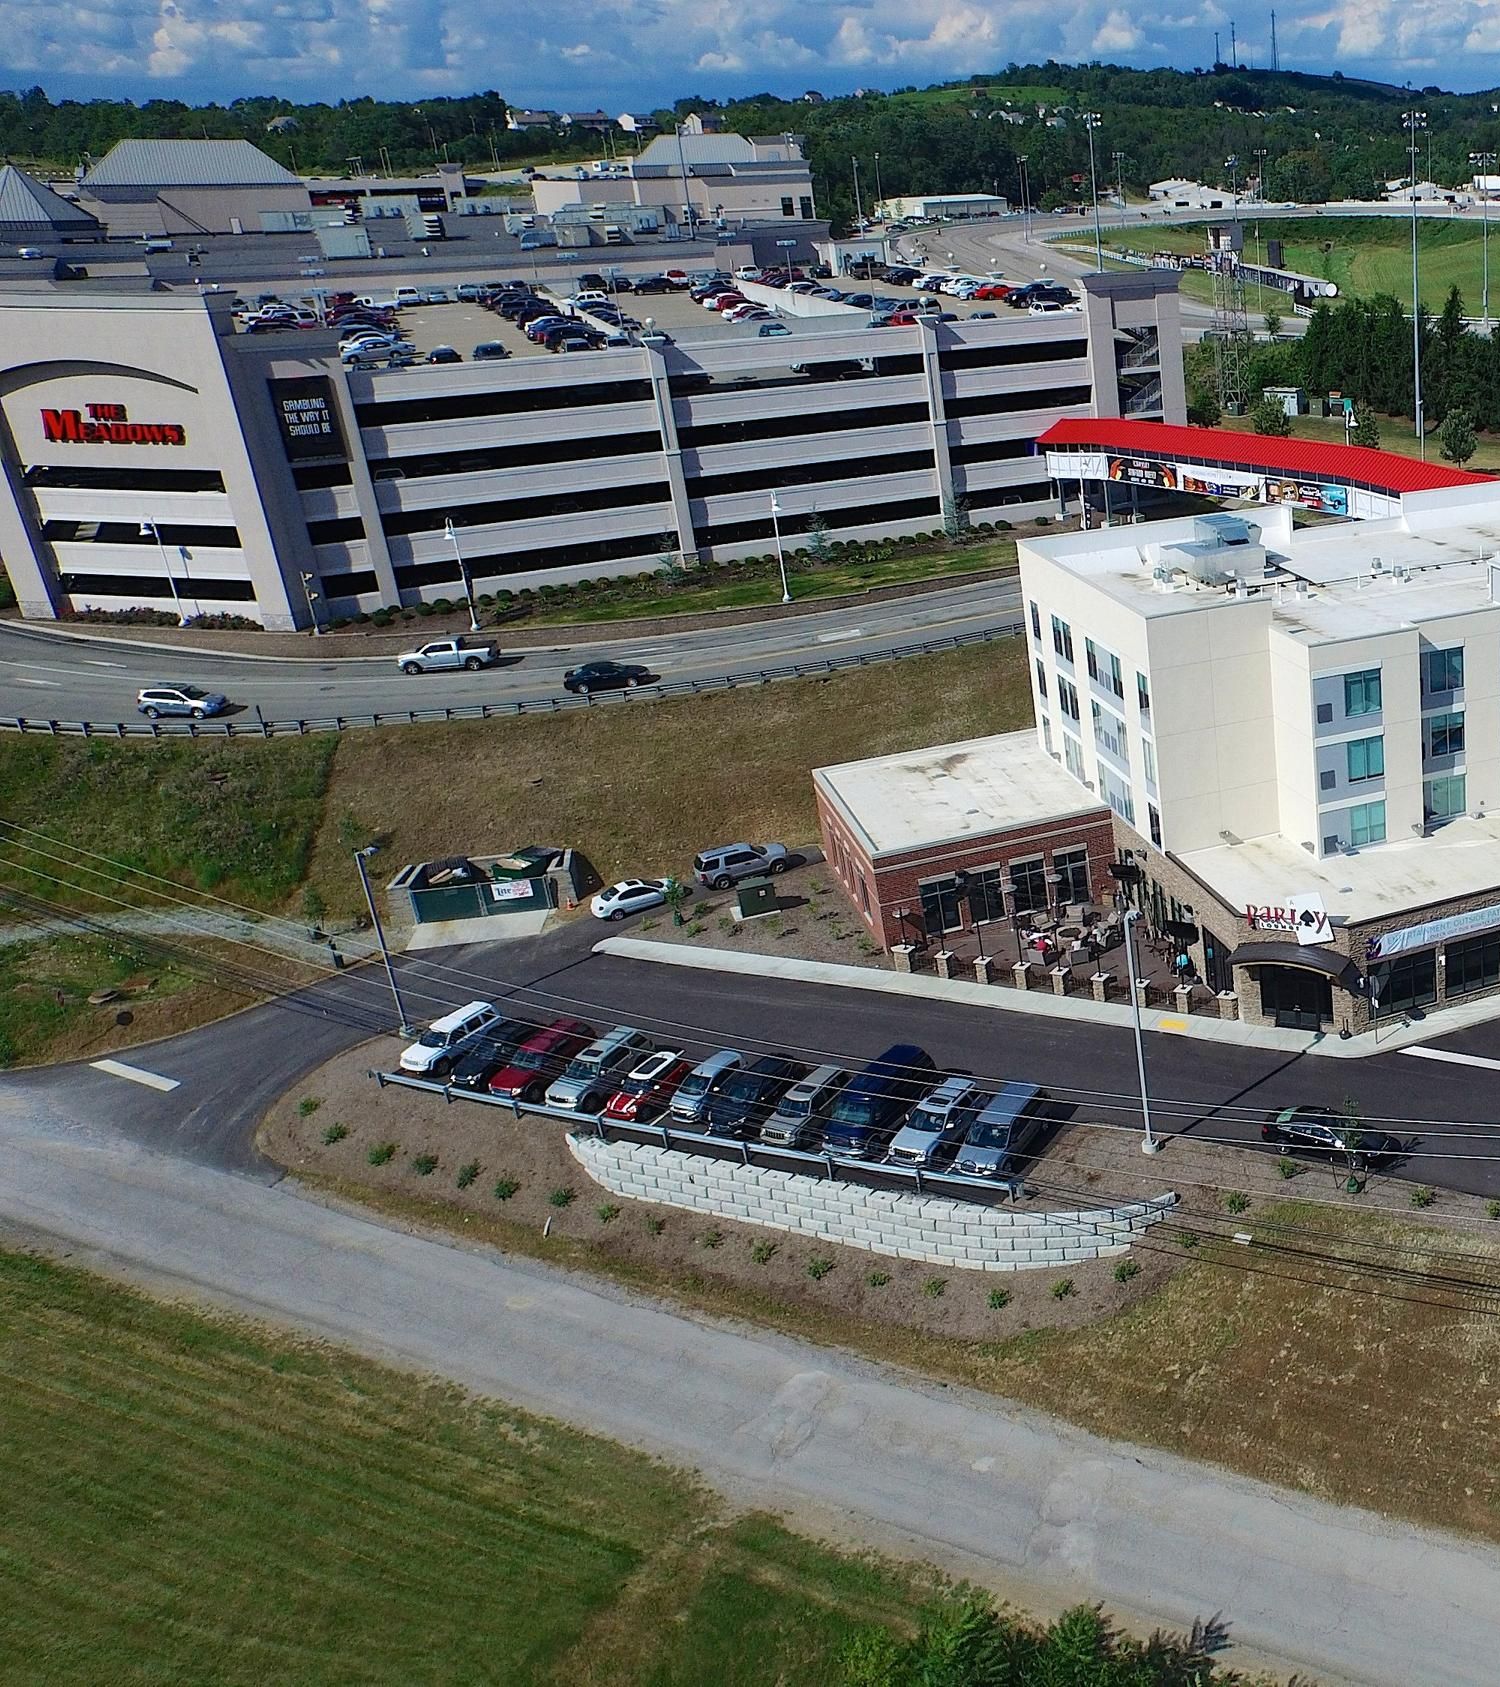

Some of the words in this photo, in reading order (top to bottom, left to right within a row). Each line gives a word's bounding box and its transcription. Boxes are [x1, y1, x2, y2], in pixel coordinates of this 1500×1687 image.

[86, 403, 126, 421] THE
[284, 412, 299, 424] THE
[300, 411, 319, 423] WAY
[322, 410, 330, 421] IT
[41, 409, 185, 444] MEADOWS
[289, 424, 320, 436] SHOULD
[321, 422, 331, 433] BE
